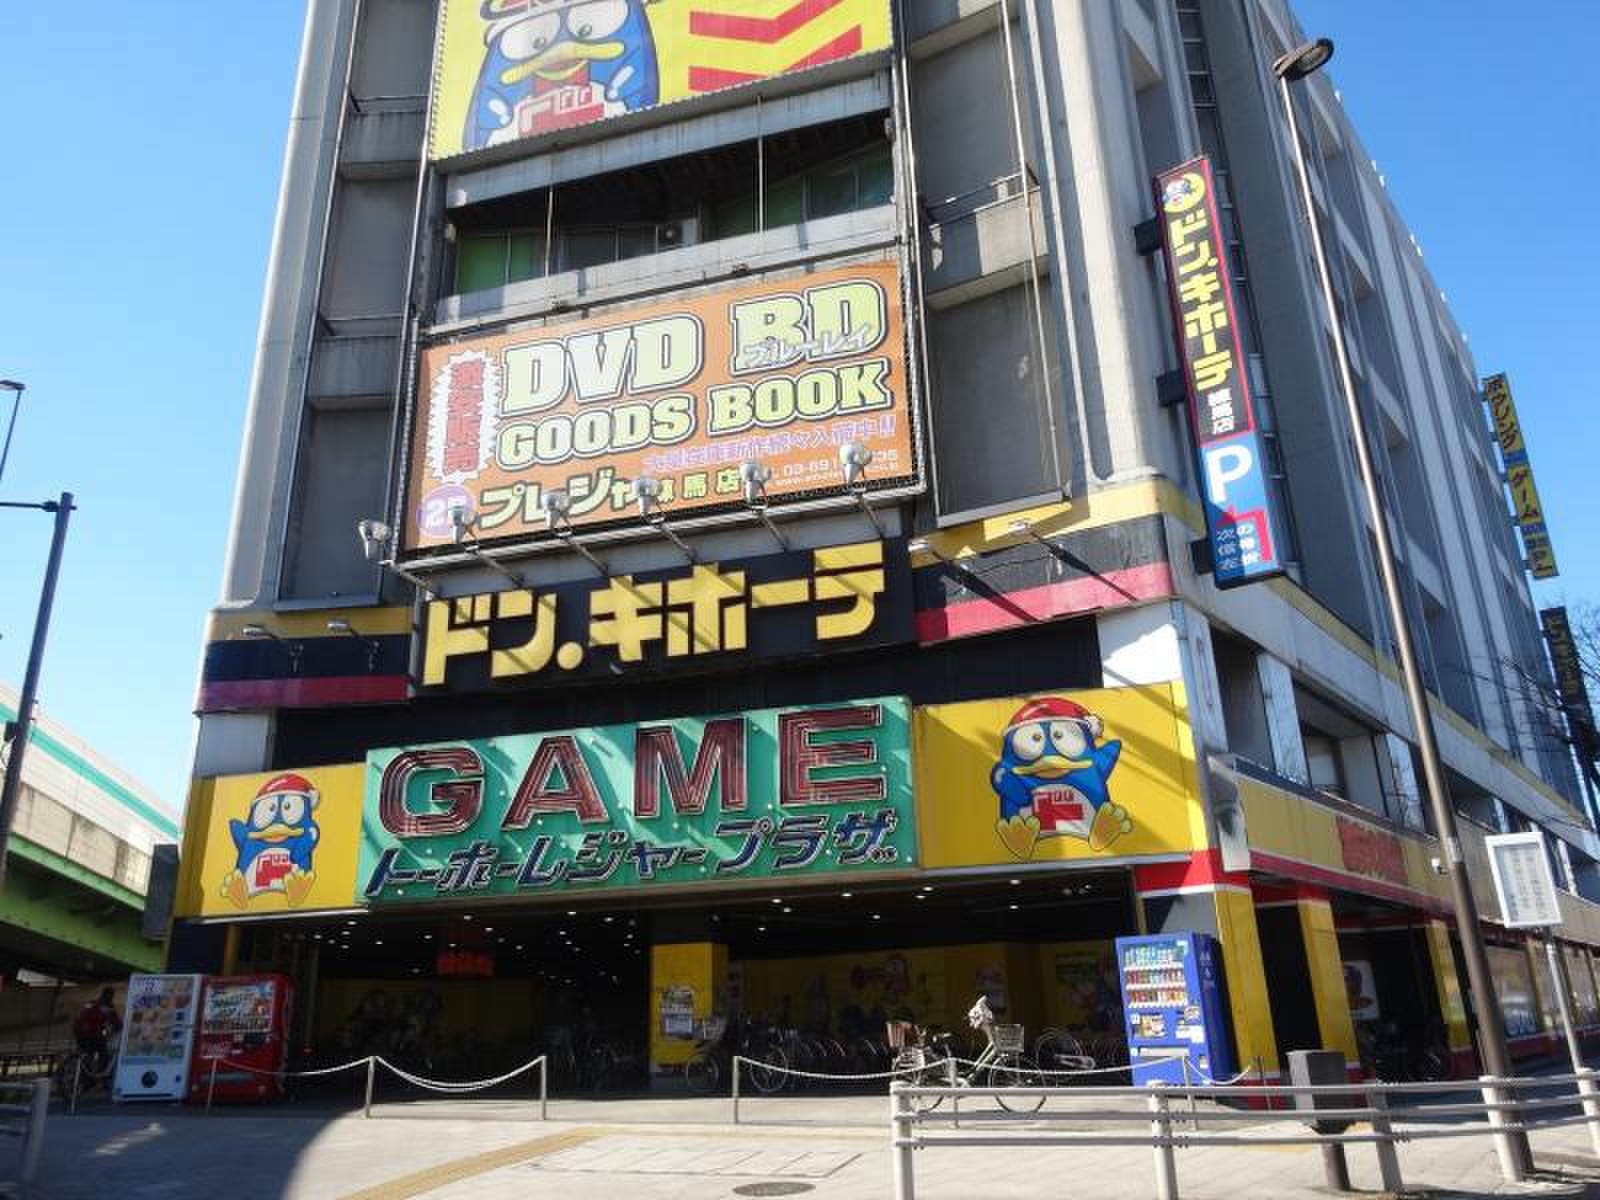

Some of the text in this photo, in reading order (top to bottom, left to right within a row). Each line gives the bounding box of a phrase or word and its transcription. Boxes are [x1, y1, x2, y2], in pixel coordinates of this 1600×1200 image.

[502, 279, 886, 416] DVD BD
[496, 393, 694, 470] GOODS
[706, 359, 891, 436] BOOK
[1206, 445, 1252, 503] P
[377, 702, 887, 839] GAME
[364, 807, 898, 897] トーホーレジャープラザ
